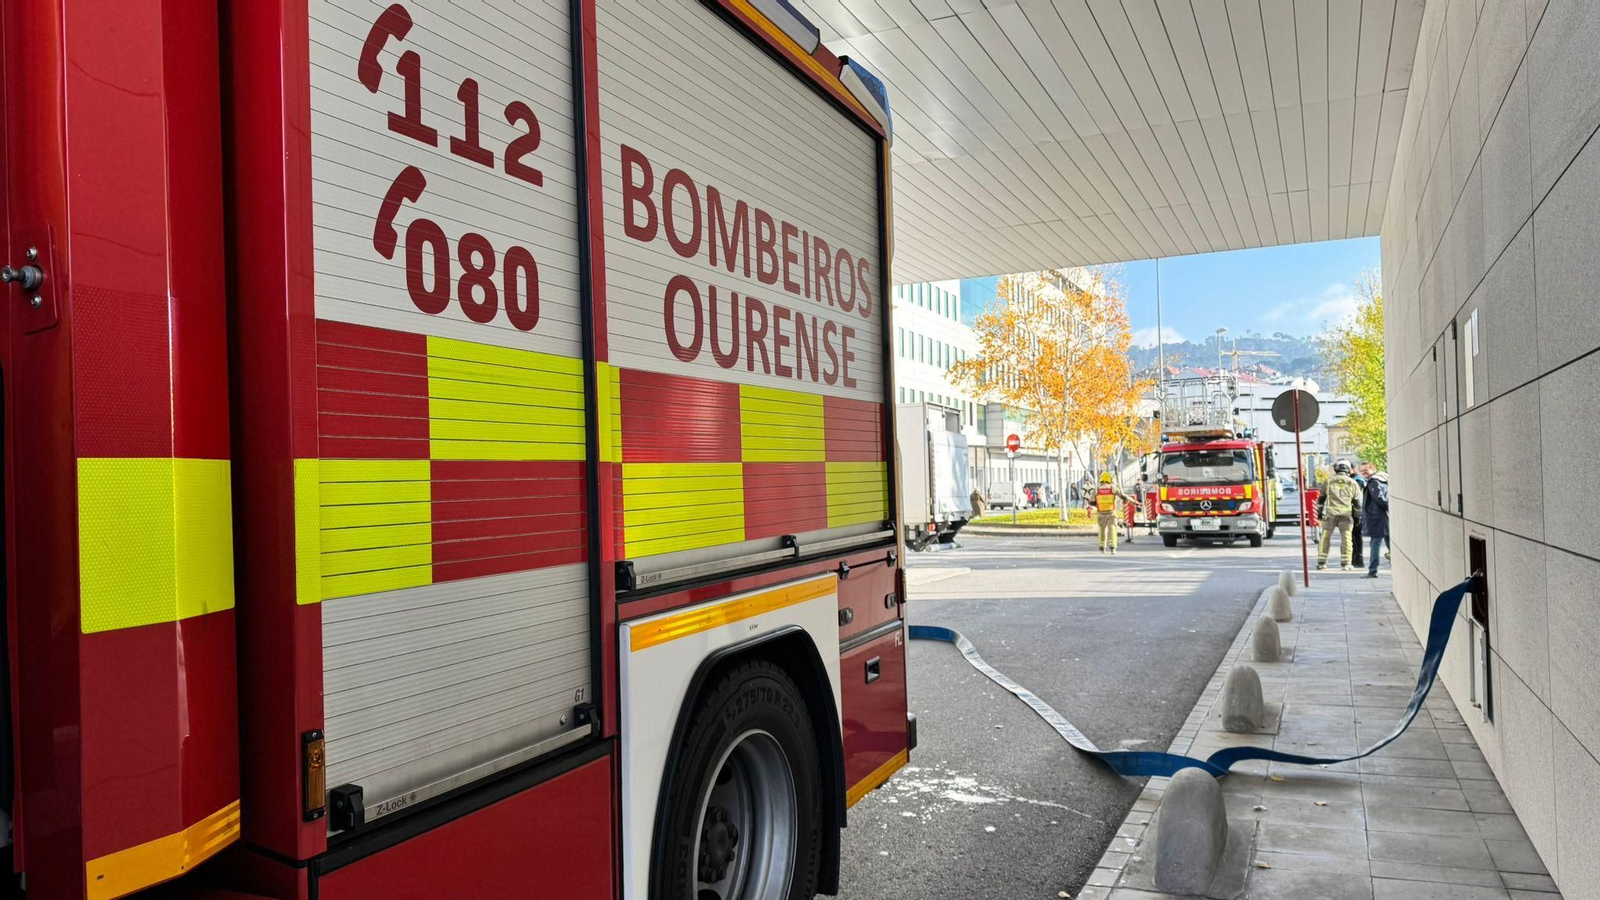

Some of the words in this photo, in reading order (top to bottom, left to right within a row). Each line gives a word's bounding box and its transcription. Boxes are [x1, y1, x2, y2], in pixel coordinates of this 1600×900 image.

[387, 50, 543, 187] 112
[405, 218, 540, 332] 080
[620, 143, 873, 318] BOMBEIROS
[664, 275, 857, 388] OURENSE
[574, 688, 584, 702] G1
[736, 687, 772, 713] 275/70
[775, 690, 782, 707] R
[376, 796, 407, 815] Z-Lock
